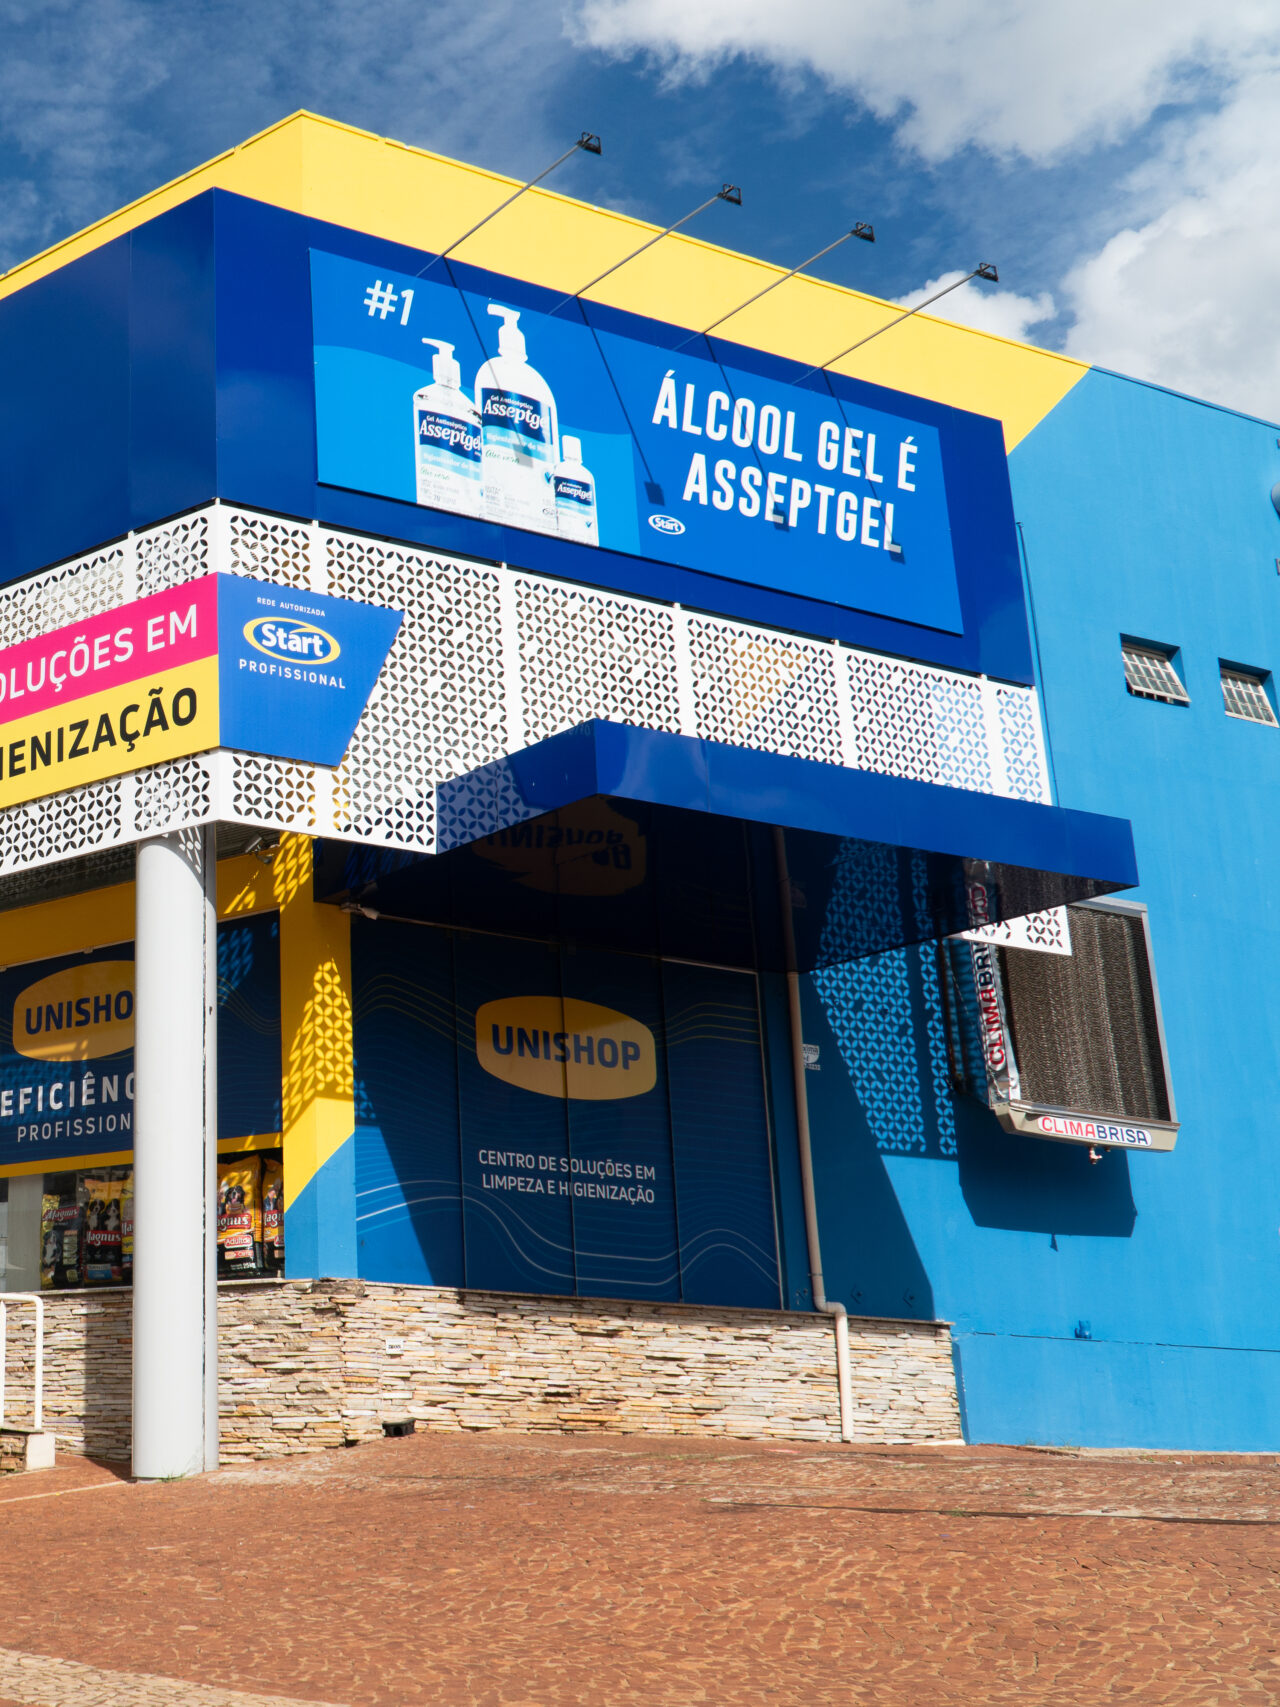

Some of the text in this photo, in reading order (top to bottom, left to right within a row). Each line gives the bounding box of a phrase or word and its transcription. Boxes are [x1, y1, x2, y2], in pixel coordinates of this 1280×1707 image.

[363, 279, 415, 326] #1
[651, 369, 918, 492] ÁLCOOL GEL É
[682, 452, 902, 554] ASSEPTGEL
[654, 516, 680, 532] Start
[256, 596, 326, 617] REDE AUTORIZADA
[146, 603, 198, 653] EM
[261, 623, 324, 657] Start
[239, 658, 346, 689] PROFISSIONAL
[25, 989, 134, 1035] UNISHO
[973, 940, 1005, 1065] CLIMABRI
[491, 1023, 641, 1071] UNISHOP
[0, 1071, 135, 1117] EFICIÊNC
[17, 1111, 132, 1143] PROFISSION
[1041, 1116, 1148, 1145] CLIMABRISA
[478, 1149, 656, 1181] CENTRO DE SOLUÇÕES EM
[481, 1173, 656, 1205] LIMPEZA E HIGIENIZAÇÃO
